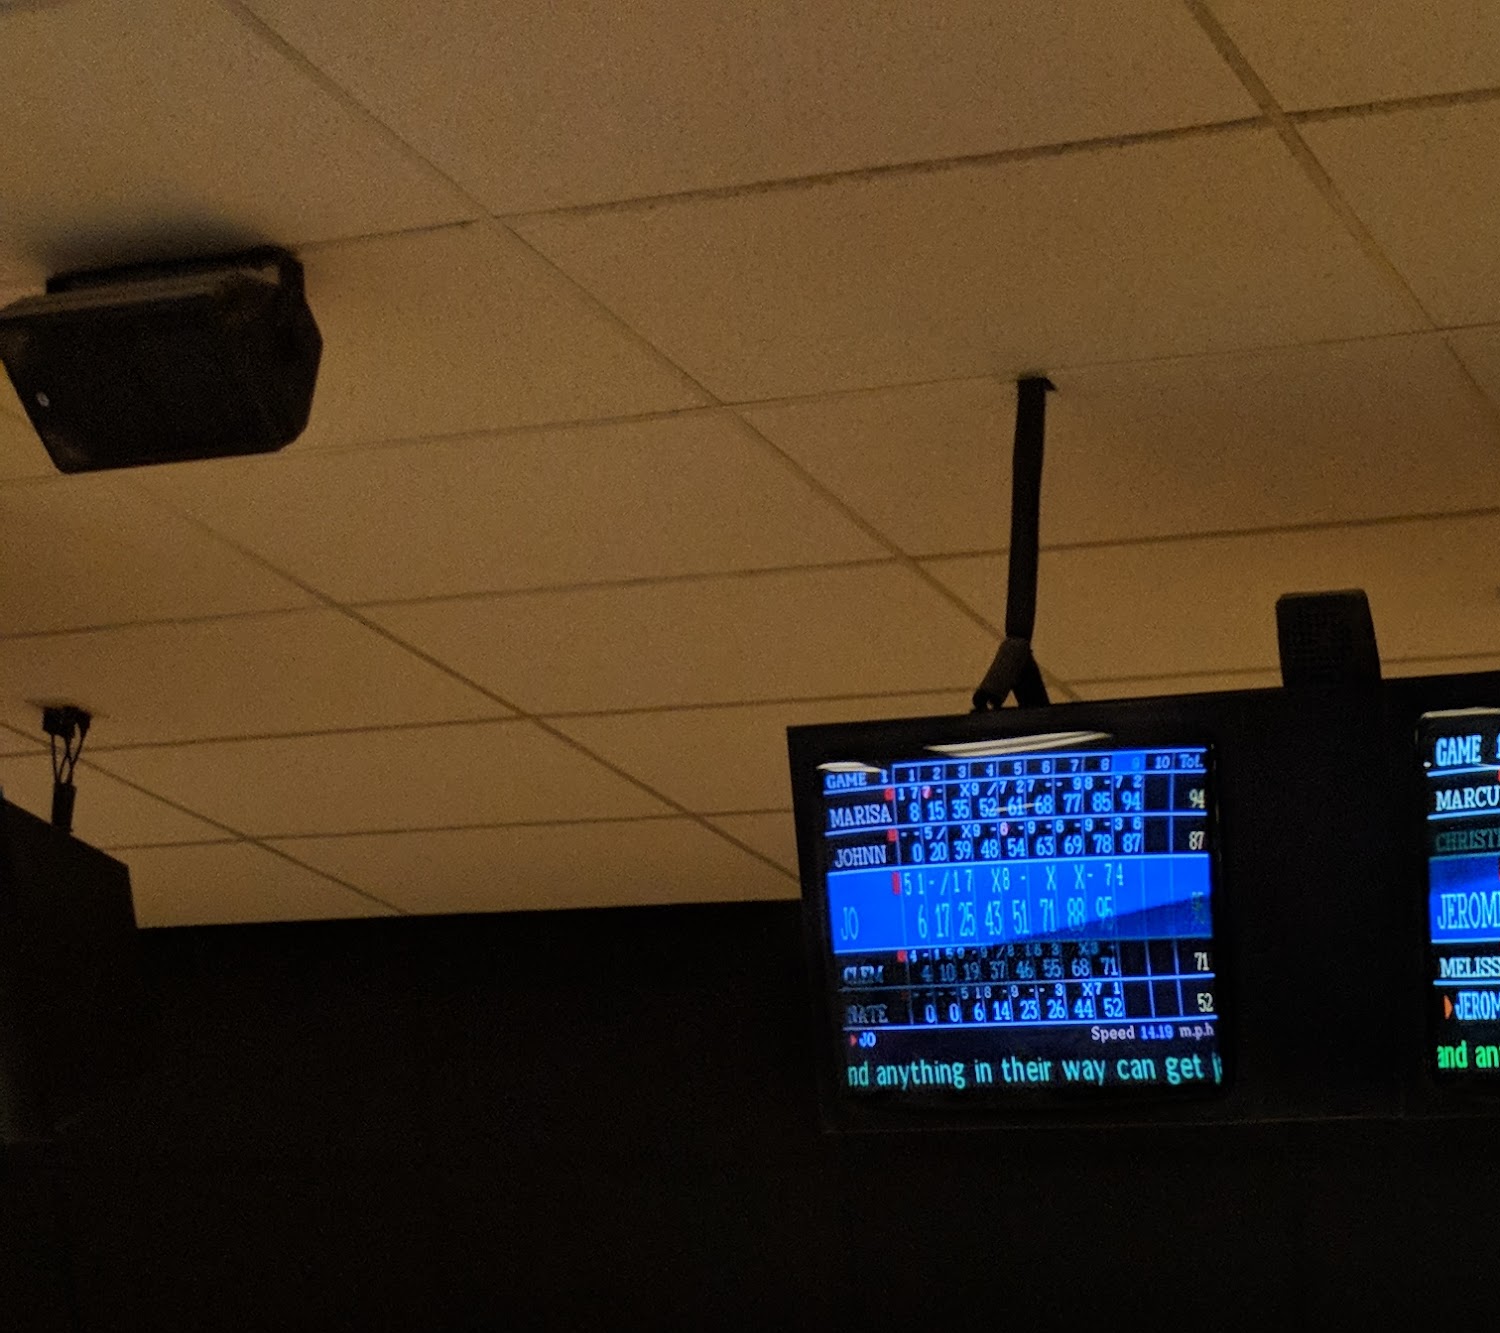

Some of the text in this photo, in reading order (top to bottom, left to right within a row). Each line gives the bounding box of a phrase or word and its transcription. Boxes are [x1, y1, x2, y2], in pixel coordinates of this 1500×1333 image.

[1436, 735, 1482, 766] GAME
[826, 772, 867, 789] GAME
[881, 769, 889, 784] 1
[1155, 756, 1170, 769] 10
[829, 789, 1205, 828] MARISA 8 15 35 52 61 68 77 85 94 94
[1435, 786, 1500, 811] MARCU
[835, 831, 1205, 868] JOHNN 0 20 39 48 54 63 69 78 87 87
[841, 907, 859, 940] JO
[918, 904, 927, 939] 6
[935, 903, 950, 938] 17
[958, 902, 975, 937] 25
[985, 901, 1003, 936] 43
[1012, 899, 1029, 934] 51
[1039, 899, 1056, 932] 71
[1194, 952, 1210, 971] 71
[1197, 993, 1213, 1013] 52
[859, 1032, 876, 1047] JO
[1091, 1026, 1135, 1043] Speed
[1437, 1040, 1468, 1069] and
[848, 1061, 869, 1087] nd
[876, 1058, 966, 1090] anything
[974, 1059, 993, 1083] in
[1001, 1056, 1052, 1083] their
[1062, 1060, 1106, 1086] way
[1116, 1058, 1157, 1080] can
[1165, 1054, 1204, 1085] get
